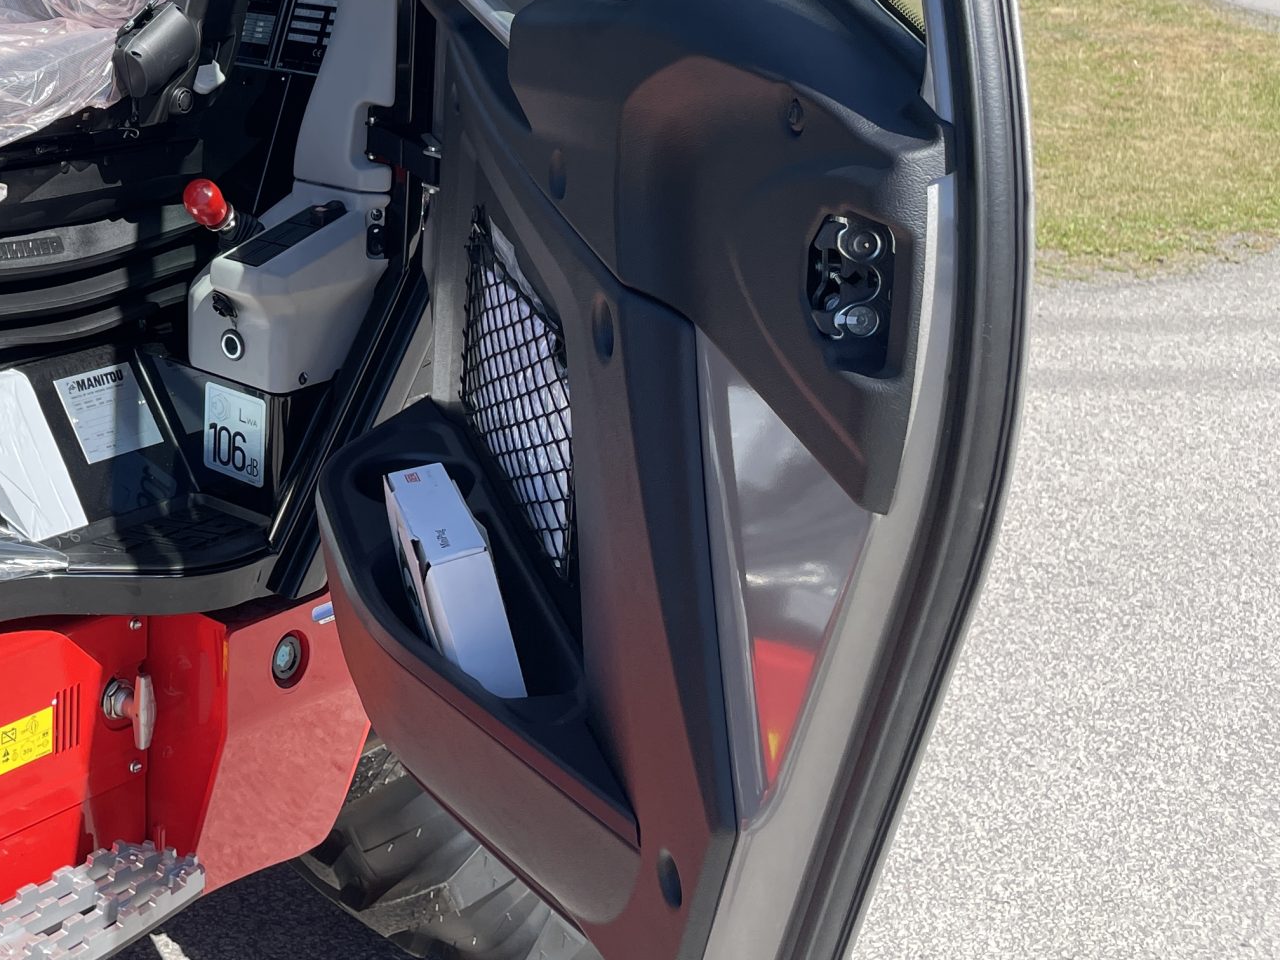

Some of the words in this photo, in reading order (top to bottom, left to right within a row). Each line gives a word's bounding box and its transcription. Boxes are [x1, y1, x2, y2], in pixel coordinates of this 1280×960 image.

[76, 369, 124, 392] MANITOU
[208, 422, 247, 472] 106
[246, 457, 259, 478] dB
